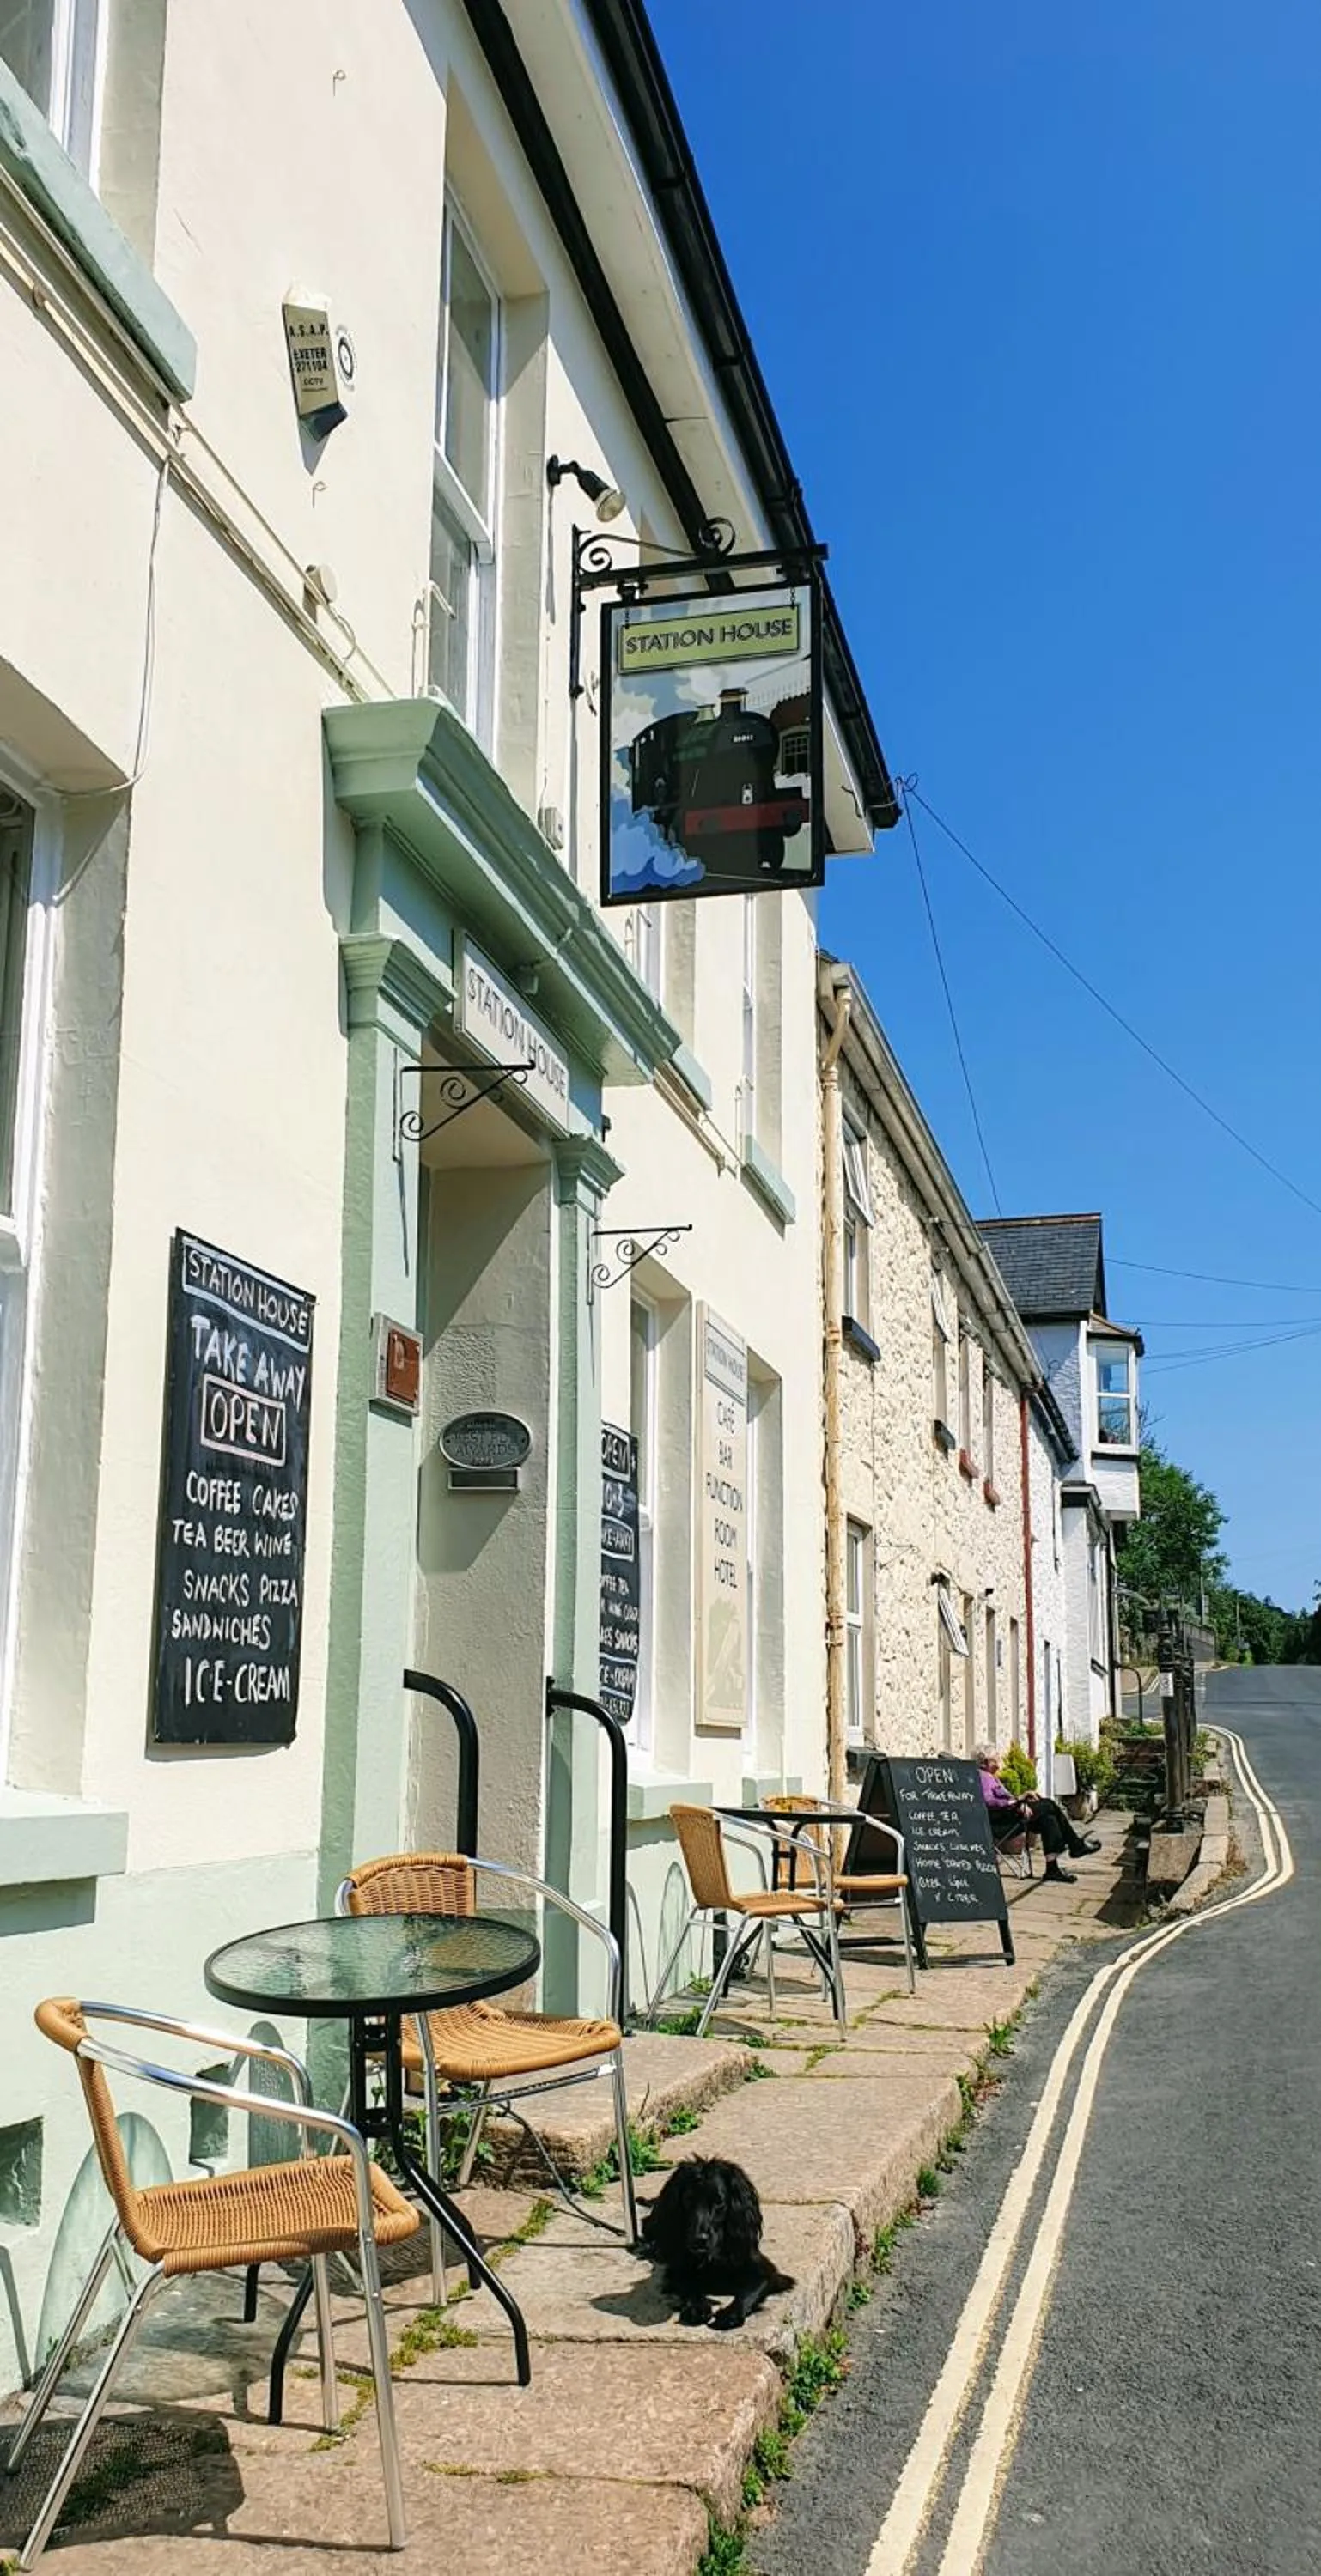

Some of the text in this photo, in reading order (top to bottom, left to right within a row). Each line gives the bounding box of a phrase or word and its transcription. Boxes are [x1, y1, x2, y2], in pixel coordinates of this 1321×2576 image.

[289, 324, 329, 337] A.S.A.P.
[293, 347, 327, 360] EXETER
[625, 618, 793, 655] STATION HOUSE
[468, 968, 565, 1098] STATION HOUSE
[189, 1249, 309, 1335] STATION HOUSE
[190, 1315, 306, 1413] TAKE AWAY
[210, 1391, 281, 1450] OPEN
[719, 1440, 734, 1471] BAR
[186, 1470, 300, 1522] COFFEE CAKES
[706, 1472, 744, 1512] FUNCTION
[172, 1519, 292, 1558] TEA BEER WINE
[714, 1517, 738, 1548] ROOM
[183, 1569, 299, 1607] SNACKS PIZZA
[714, 1557, 739, 1589] HOTEL
[185, 1657, 291, 1707] ICE-CREAM
[915, 1766, 954, 1783] OPEN
[899, 1789, 919, 1802] FOR
